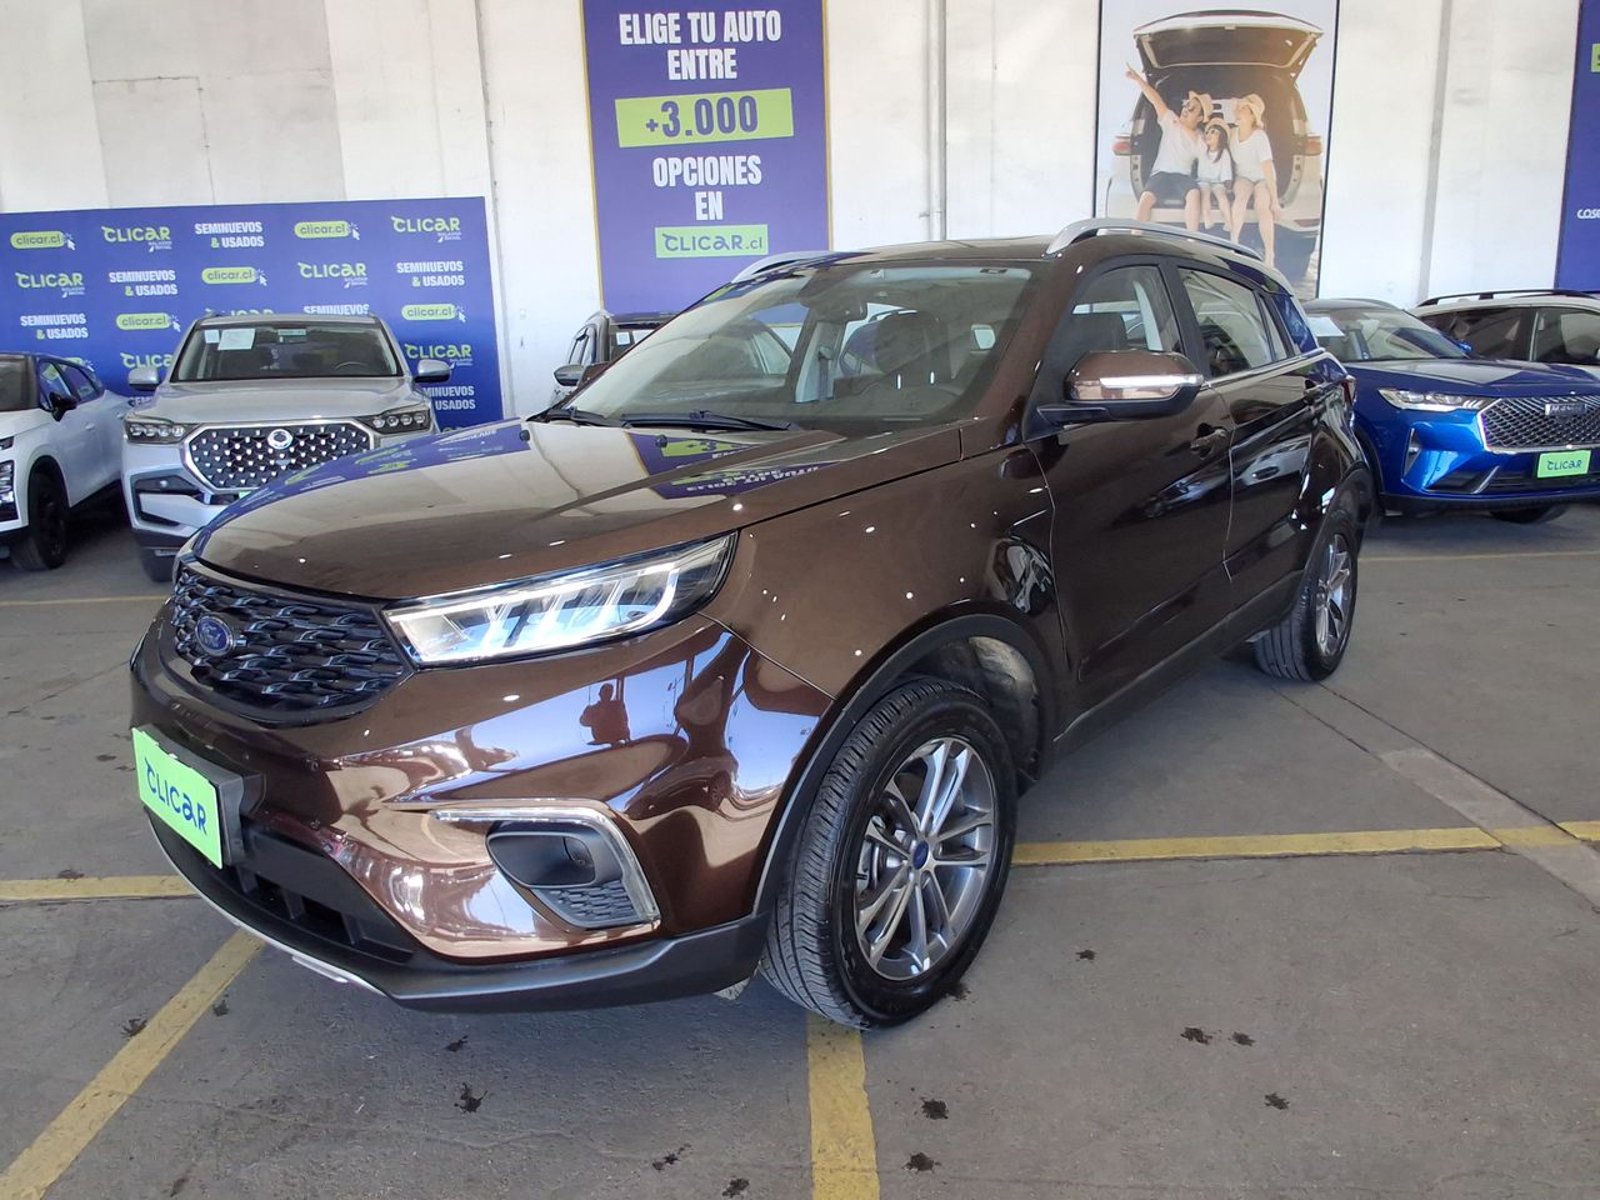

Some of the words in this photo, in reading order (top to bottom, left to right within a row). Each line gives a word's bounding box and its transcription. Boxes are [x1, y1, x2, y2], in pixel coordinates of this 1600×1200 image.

[619, 13, 681, 45] ELIGE
[687, 11, 716, 44] TU
[723, 10, 782, 42] AUTO
[667, 48, 737, 80] ENTRE
[645, 95, 758, 138] +3.000
[653, 154, 762, 187] OPCIONES
[695, 191, 723, 221] EN
[194, 221, 263, 235] SEMINUEVOS
[300, 224, 346, 235] clicar.cl
[16, 234, 62, 246] clicar.cl
[211, 237, 219, 248] &
[222, 236, 264, 248] USADOS
[396, 261, 464, 273] SEMINUEVOS
[109, 270, 176, 283] SEMINUEVOS
[207, 269, 252, 281] clicar.cl
[412, 276, 421, 287] &
[423, 274, 465, 287] USADOS
[125, 285, 134, 296] &
[135, 284, 178, 297] USADOS
[407, 306, 452, 317] clicar.cl
[20, 313, 86, 327] SEMINUEVOS
[122, 315, 166, 327] clicar.cl
[36, 329, 45, 340] &
[46, 327, 89, 340] USADOS
[120, 352, 173, 368] CLICA
[435, 399, 476, 410] USADOS
